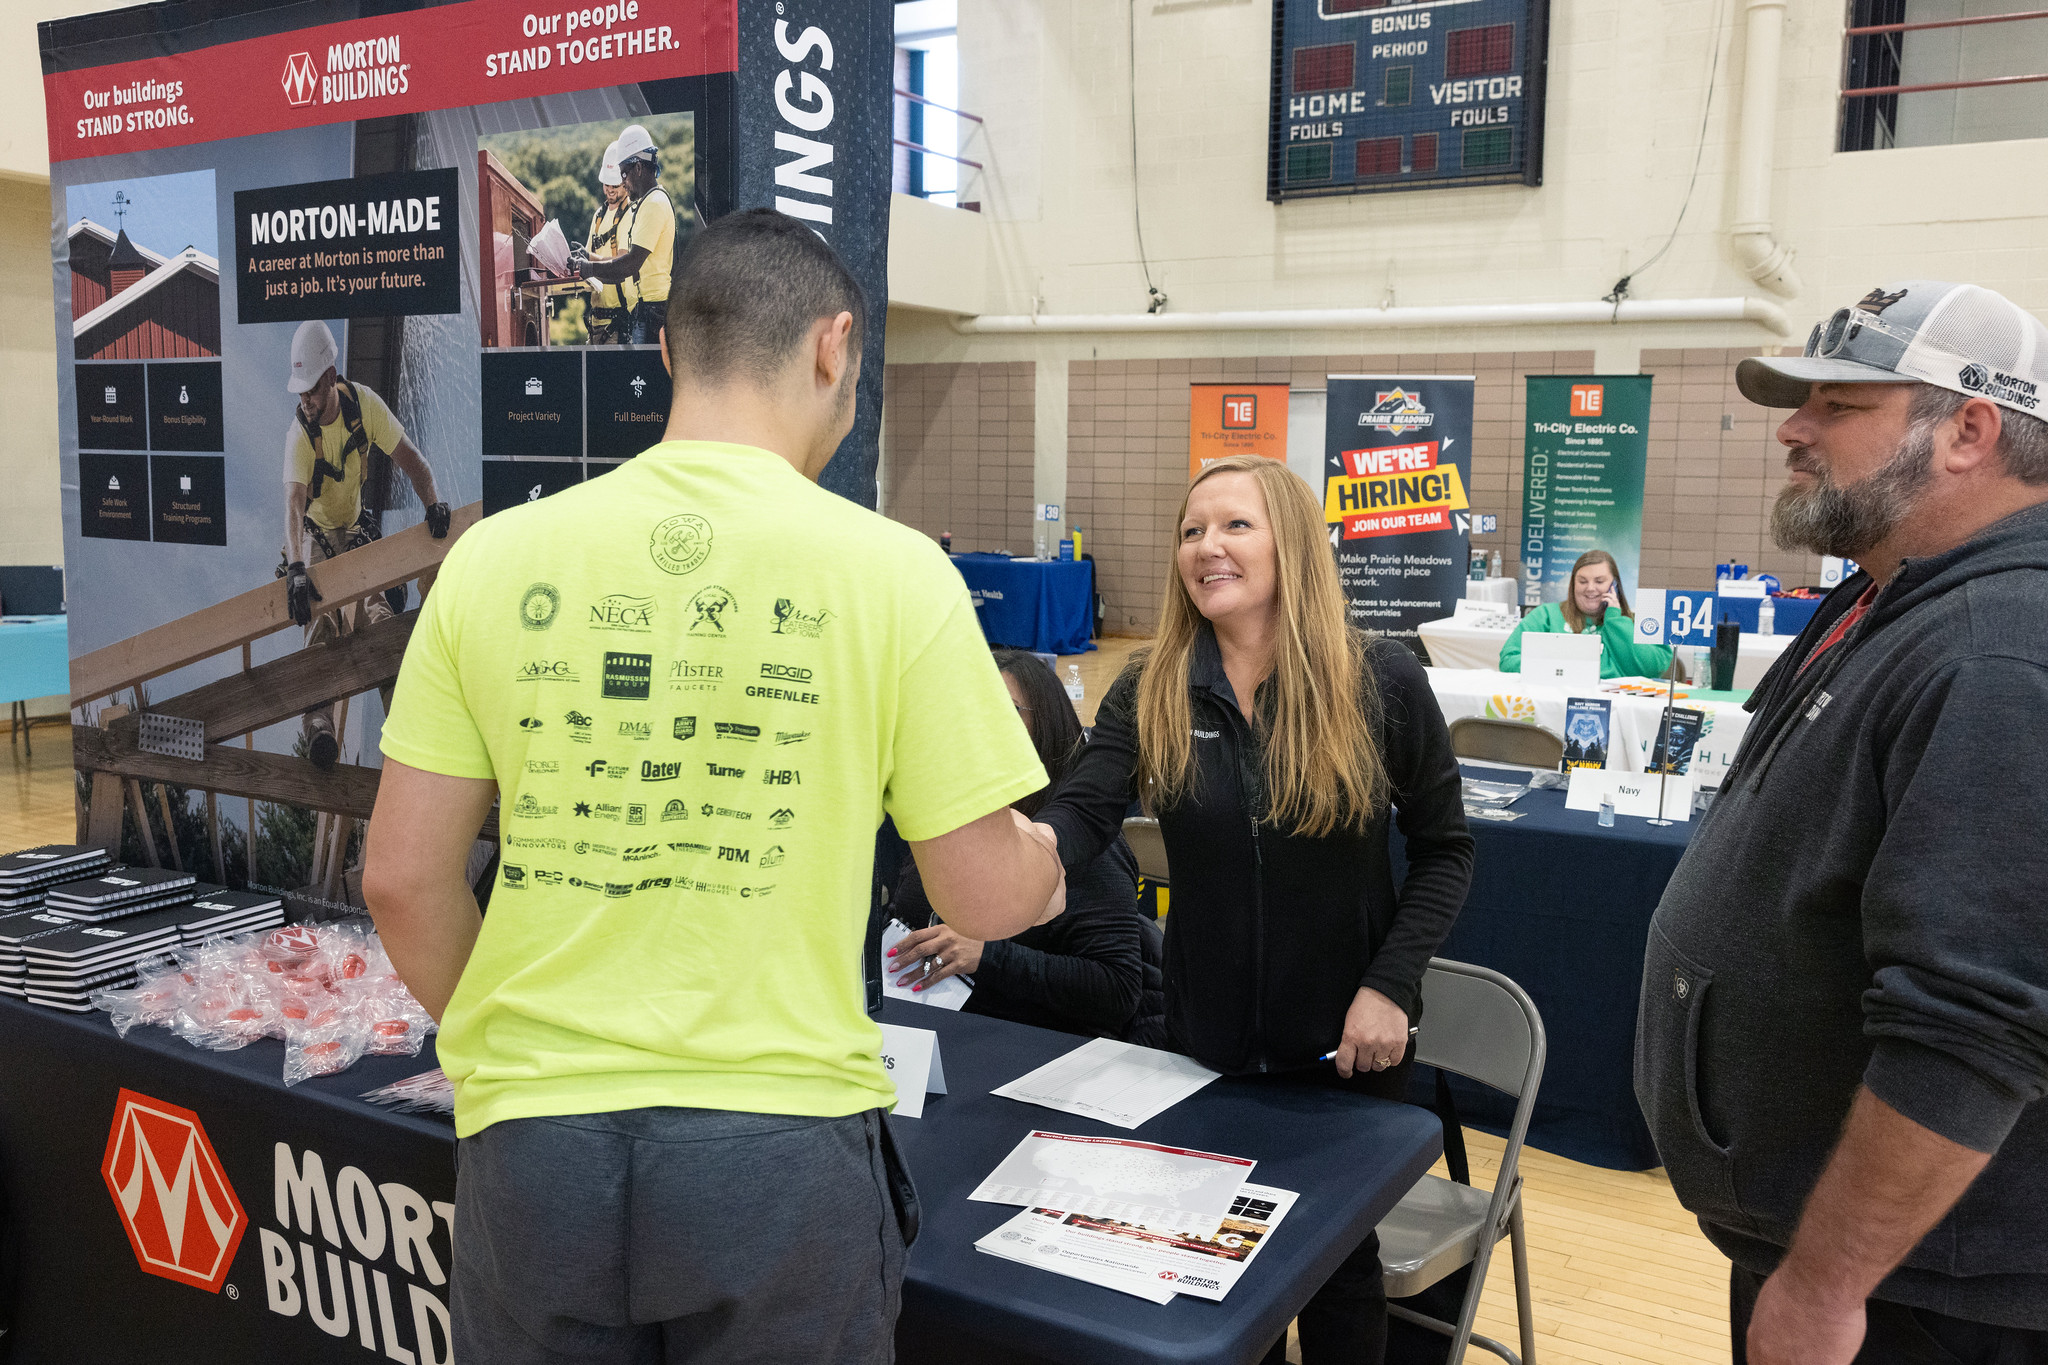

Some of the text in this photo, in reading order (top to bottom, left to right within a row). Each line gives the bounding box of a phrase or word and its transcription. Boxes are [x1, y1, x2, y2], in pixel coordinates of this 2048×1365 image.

[522, 0, 639, 38] Our people
[1371, 13, 1431, 34] BONUS
[327, 35, 400, 73] MORTON
[485, 26, 680, 77] STAND TOGETHER.
[1372, 41, 1428, 59] PERIOD
[322, 64, 408, 104] BUILDINGS
[1429, 75, 1523, 105] VISITOR
[84, 80, 184, 110] Our buildings
[1289, 92, 1366, 119] HOME
[77, 105, 194, 139] STAND STRONG.
[774, 19, 834, 228] INGS
[1451, 106, 1509, 127] FOULS
[1290, 122, 1343, 141] FOULS
[250, 196, 441, 245] MORTON-MADE
[248, 243, 445, 273] A career at Morton is more than
[264, 272, 426, 300] just a job. It’s your future.
[1993, 372, 2037, 395] MORTON
[91, 415, 133, 424] Year-Round Work
[163, 415, 206, 425] Bonus Eligibility
[508, 411, 561, 423] Project Variety
[614, 412, 664, 423] Full Benefits
[1362, 415, 1431, 424] PRAIRIE MEADOWS
[1201, 432, 1229, 440] Tri-City
[1232, 432, 1261, 440] Electric
[1533, 422, 1638, 435] Tri-City Electric Co.
[1353, 446, 1430, 475] WE’RE
[1338, 473, 1451, 511] HIRING!
[102, 498, 127, 507] Safe Work
[172, 502, 200, 511] Structured
[1528, 450, 1549, 552] DELIVERED.
[99, 510, 132, 519] Environment
[163, 513, 212, 524] Training Programs
[1046, 506, 1058, 519] 39
[1352, 512, 1442, 533] JOIN OUR TEAM
[1483, 516, 1496, 531] 38
[656, 551, 704, 571] SKILLED TRADES
[1340, 554, 1452, 566] Make Prairie Meadows
[1340, 565, 1431, 578] your favorite place
[1340, 577, 1380, 587] to work.
[1525, 557, 1543, 607] ENCE
[981, 589, 1003, 600] Health
[1351, 598, 1441, 608] Access to advancement
[589, 606, 650, 626] NECA
[1350, 608, 1401, 618] opportunities
[1671, 595, 1714, 638] 34
[783, 620, 823, 633] CATERERS
[799, 630, 821, 639] IOWA
[1387, 629, 1418, 637] benefits
[605, 673, 650, 682] RASMUSSEN
[760, 663, 813, 680] RIDGID
[745, 685, 820, 705] GREENLEE
[566, 715, 593, 727] ABC
[1194, 730, 1219, 738] BUILDINGS
[641, 760, 682, 778] Oatey
[706, 762, 746, 778] Turner
[1618, 785, 1641, 796] Navy
[513, 842, 566, 850] INNOVATORS
[636, 877, 673, 891] Kreg
[247, 881, 267, 891] Morton
[268, 886, 296, 900] Buildings,
[297, 892, 307, 902] Inc.
[322, 899, 339, 910] Equal
[274, 1142, 456, 1287] MORT
[1078, 1231, 1104, 1241] buildings
[1158, 1249, 1180, 1258] people
[1181, 1252, 1199, 1260] stand
[1062, 1249, 1140, 1269] Opportunities Nationwide
[1177, 1278, 1221, 1291] BUILDINGS
[1183, 1274, 1221, 1286] MORTON
[260, 1227, 452, 1365] BUILD
